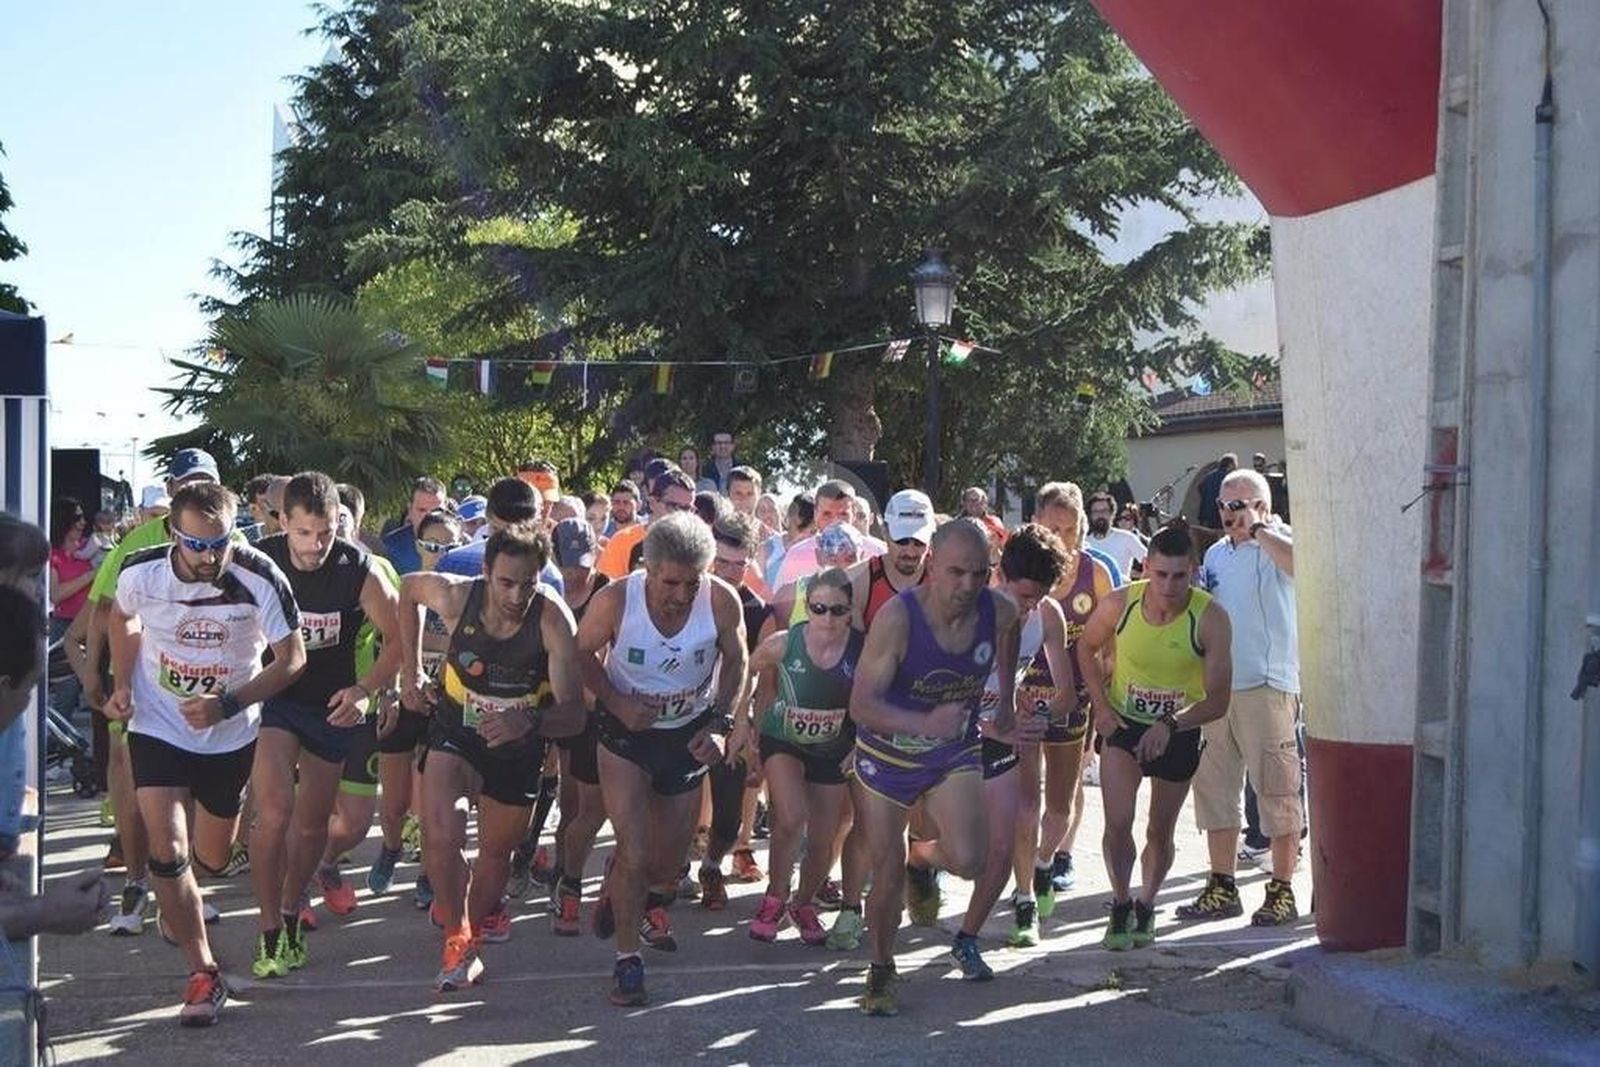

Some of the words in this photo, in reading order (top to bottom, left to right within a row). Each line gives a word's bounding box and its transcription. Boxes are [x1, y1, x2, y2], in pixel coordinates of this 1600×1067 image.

[169, 669, 217, 693] 879
[1135, 698, 1176, 714] 878
[794, 720, 834, 737] 903
